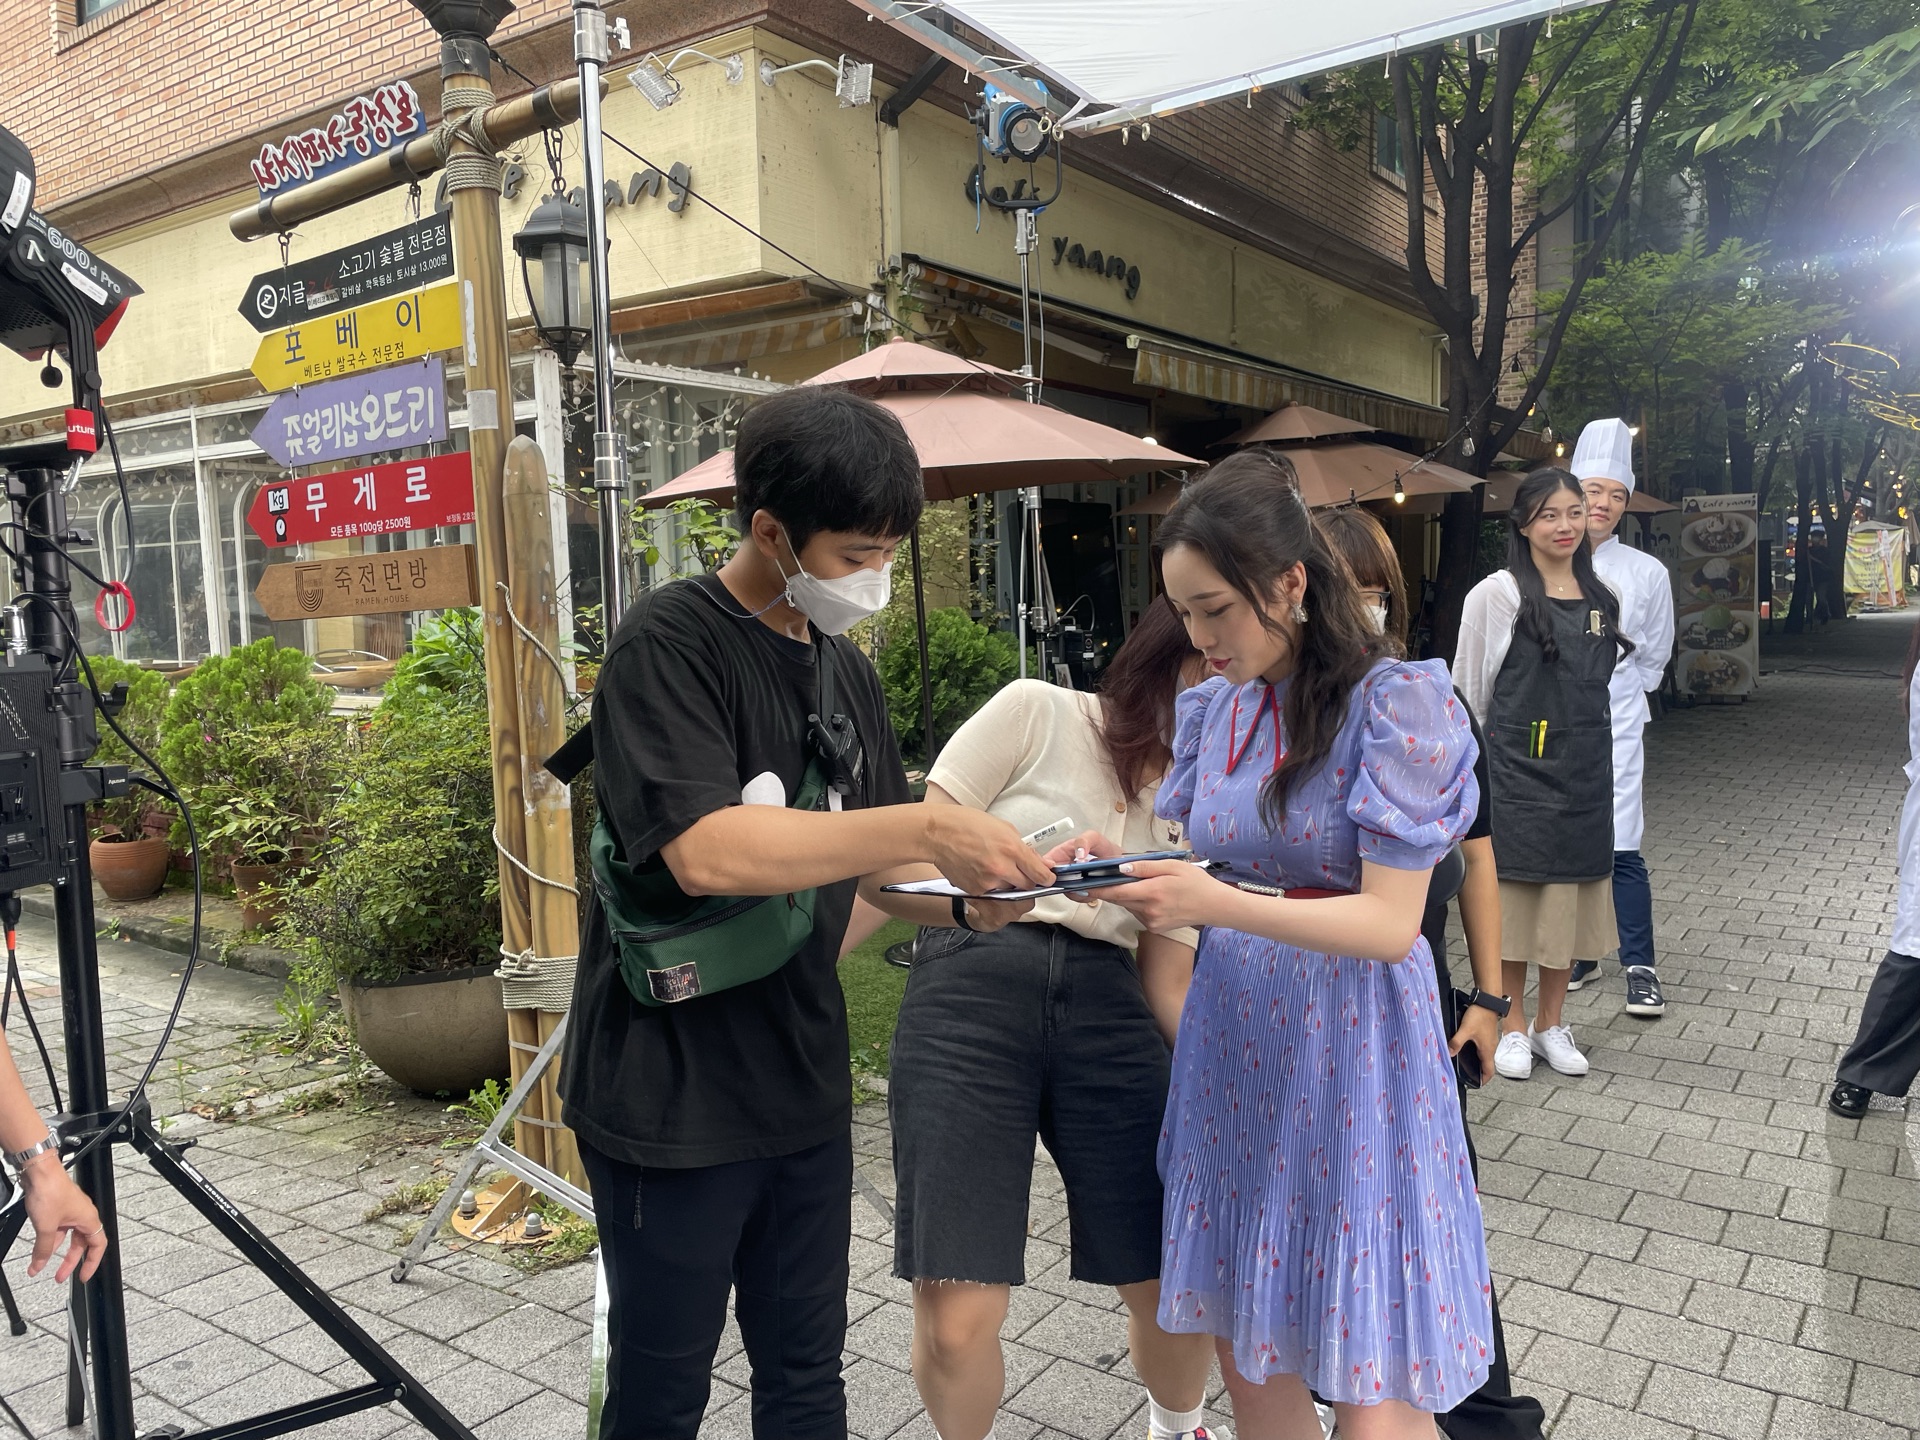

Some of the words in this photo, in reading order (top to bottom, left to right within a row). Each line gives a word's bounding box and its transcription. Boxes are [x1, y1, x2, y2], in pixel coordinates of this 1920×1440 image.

[338, 250, 376, 279] 소고기
[380, 240, 404, 266] 숯불
[408, 224, 447, 256] 전문점
[1052, 236, 1141, 299] yaang
[100, 270, 121, 294] Pro
[279, 281, 306, 307] 지글
[303, 362, 331, 378] 베트남
[336, 354, 367, 373] 쌀국수
[372, 342, 405, 366] 전문점
[272, 491, 285, 509] kg
[330, 526, 344, 538] 모든
[345, 524, 358, 535] 품목
[359, 521, 384, 534] 100g당
[385, 518, 412, 530] 2500원
[334, 557, 428, 596] 죽전면방
[355, 595, 382, 606] RAMEN
[383, 594, 409, 604] HOUSE
